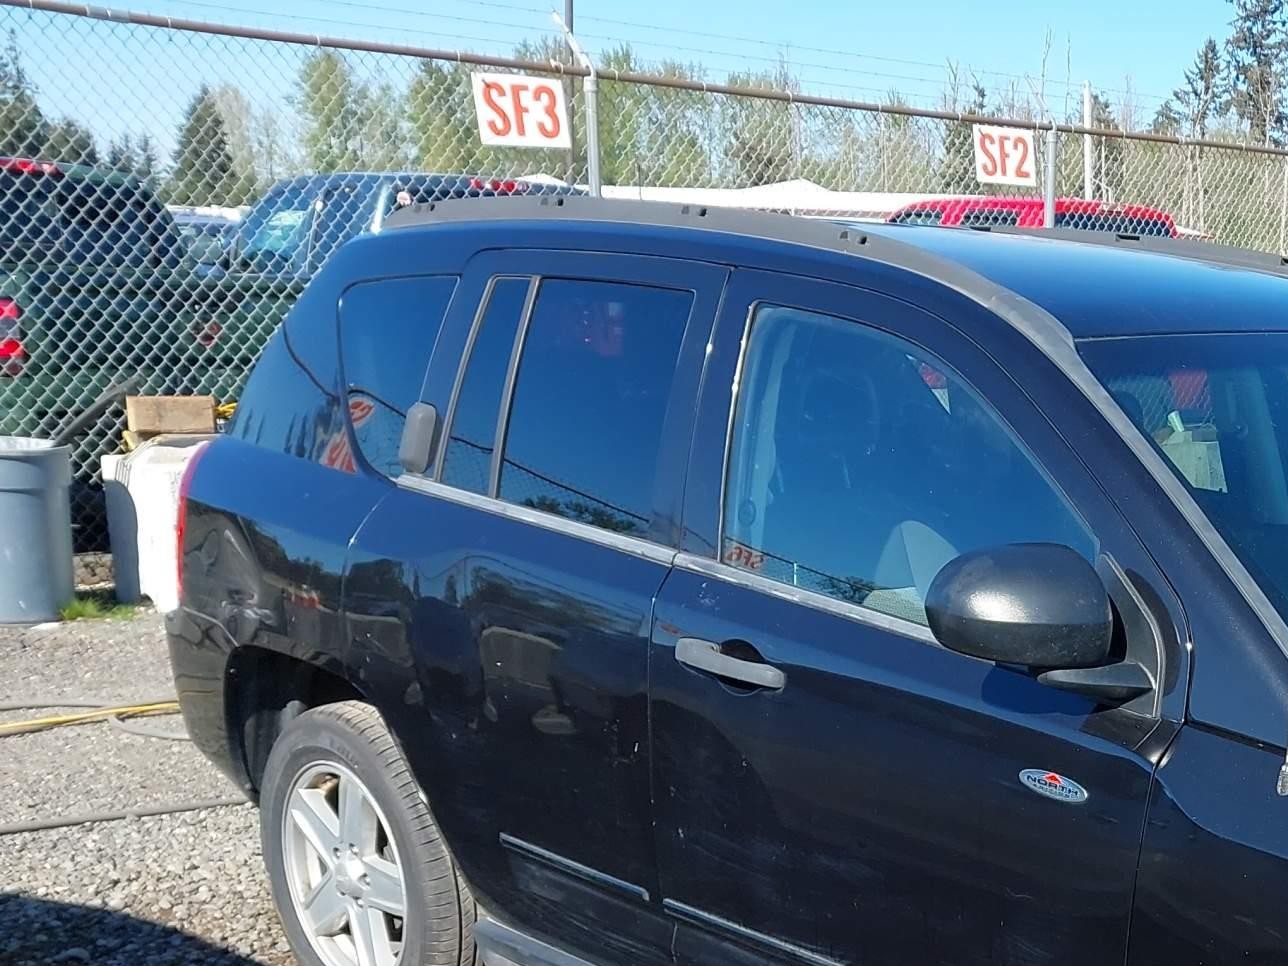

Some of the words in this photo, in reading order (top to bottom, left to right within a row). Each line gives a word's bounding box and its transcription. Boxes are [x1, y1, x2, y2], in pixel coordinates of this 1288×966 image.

[482, 81, 560, 139] SF3
[979, 133, 1031, 178] SF2
[1026, 774, 1079, 796] NORTH
